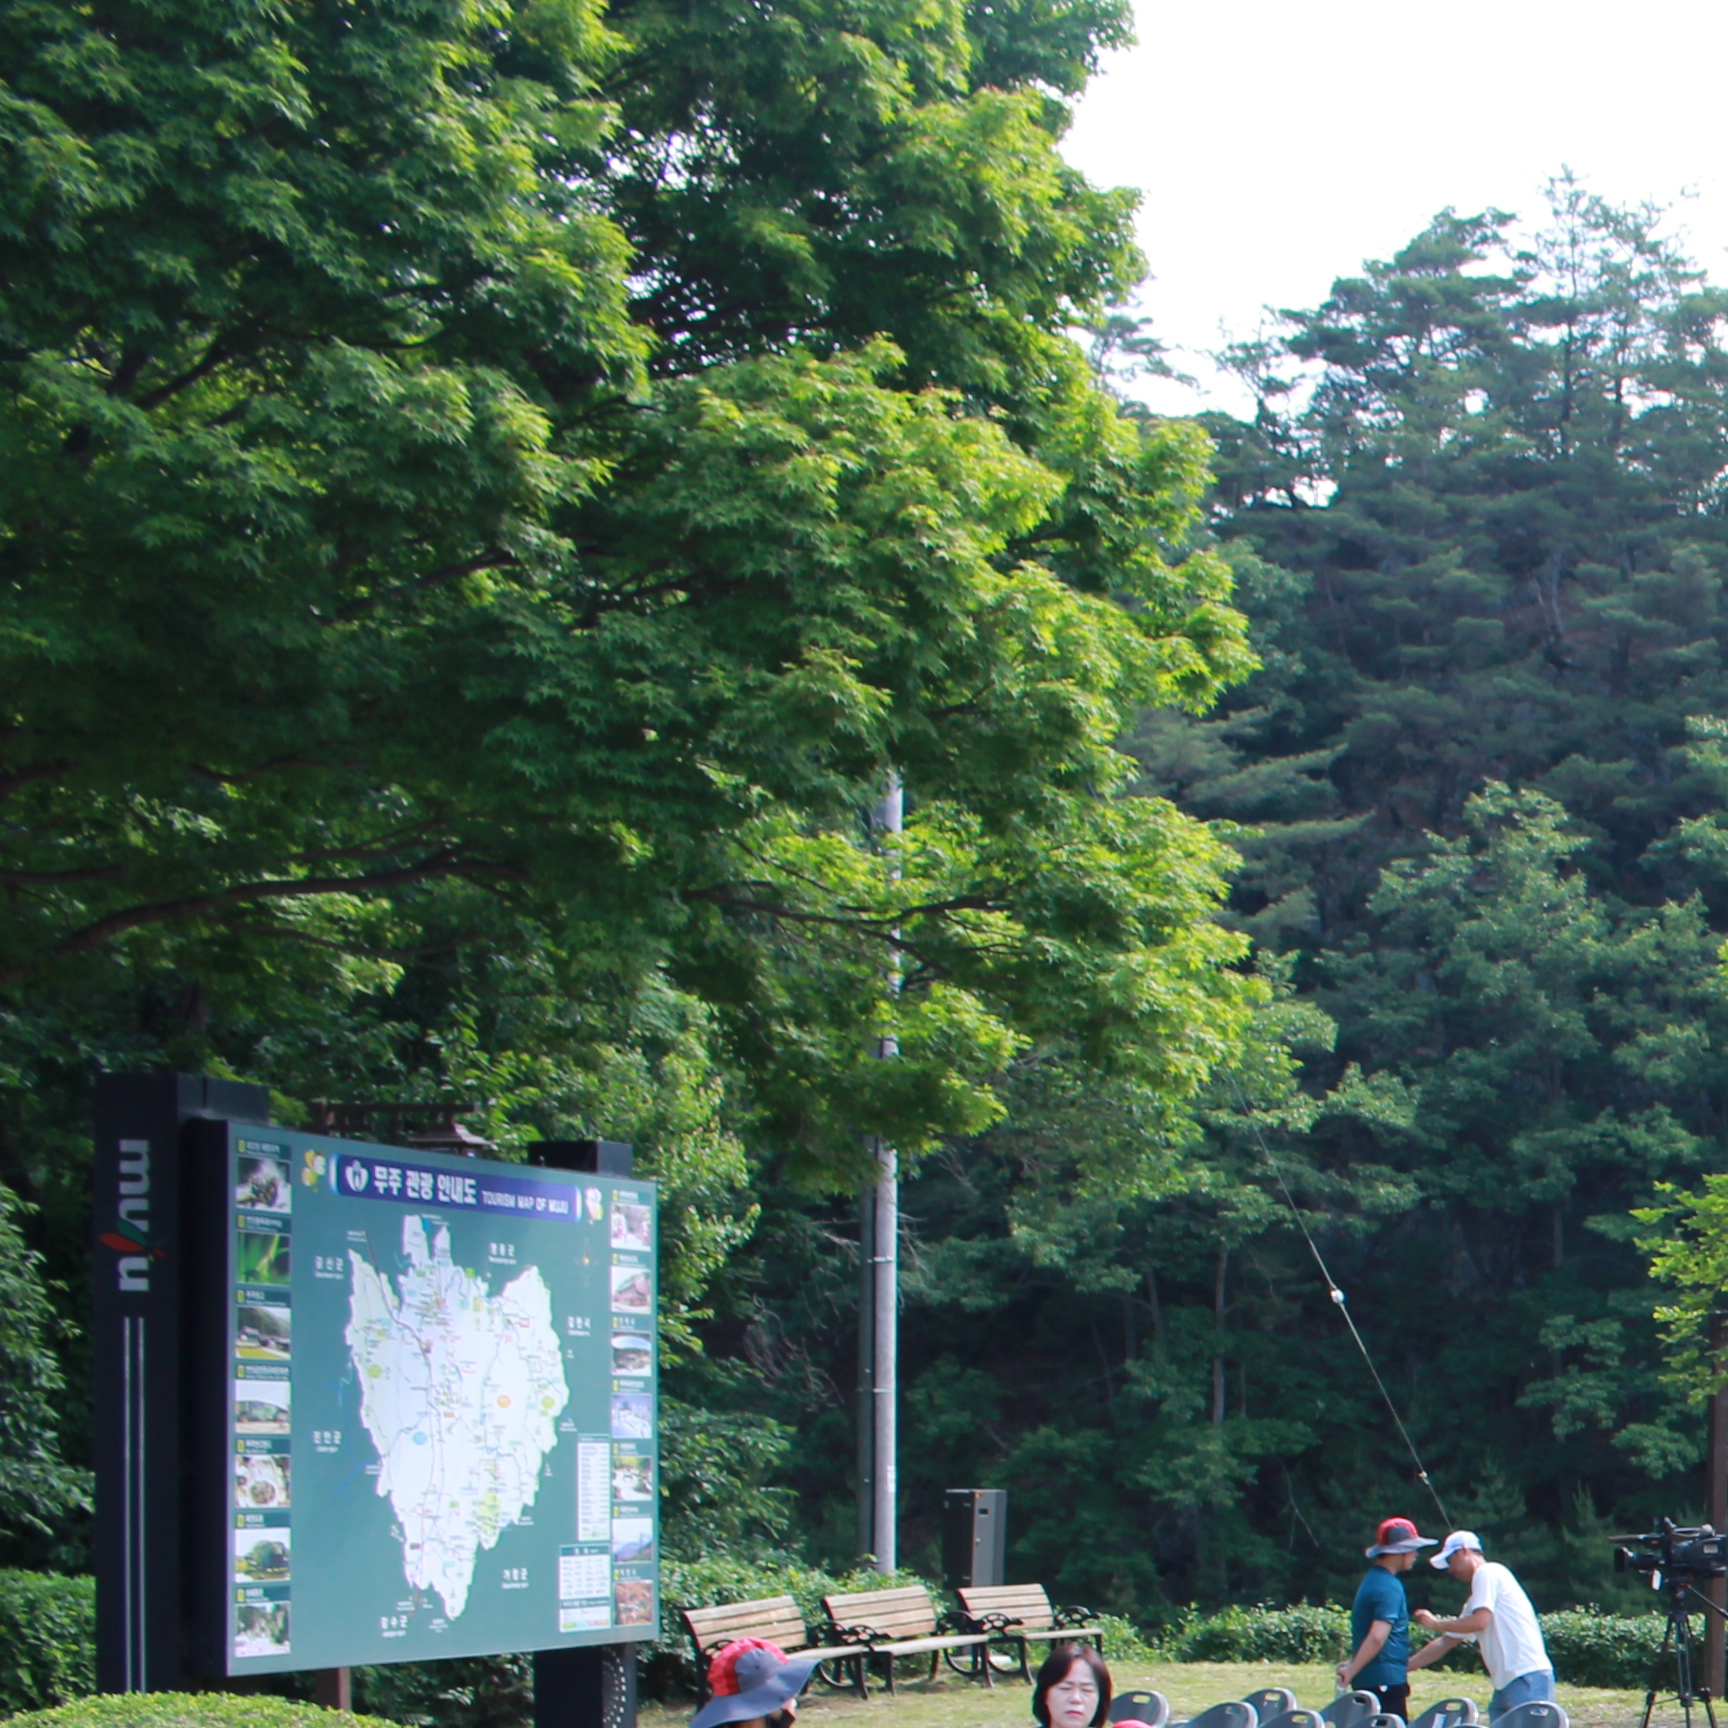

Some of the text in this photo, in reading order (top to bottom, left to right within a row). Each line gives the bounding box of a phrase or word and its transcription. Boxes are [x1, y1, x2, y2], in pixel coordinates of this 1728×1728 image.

[374, 1165, 478, 1205] 무주 관광 안내도
[482, 1189, 569, 1214] TOURISM MAP OF MUJU
